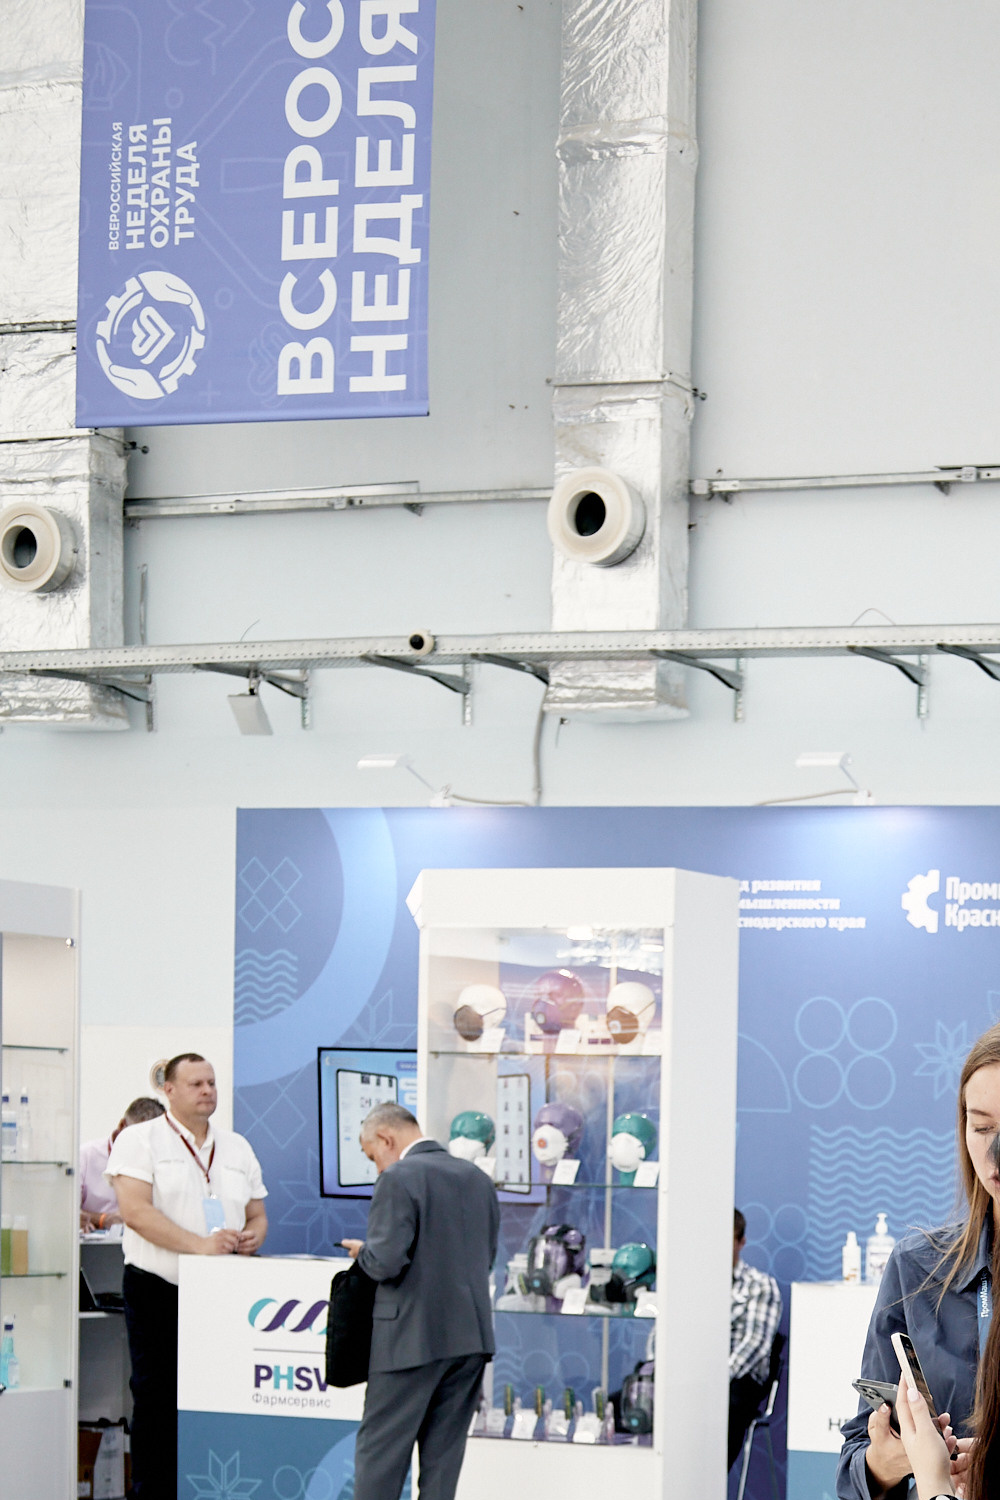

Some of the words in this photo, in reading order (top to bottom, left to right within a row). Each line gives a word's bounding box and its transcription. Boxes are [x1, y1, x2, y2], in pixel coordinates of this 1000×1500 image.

[108, 122, 123, 250] ВСЕРОССИЙСКАЯ
[126, 124, 149, 249] НЕДЕЛЯ
[150, 118, 172, 249] ОХРАНЫ
[174, 141, 200, 246] ТРУДА
[349, 0, 423, 393] НЕДЕЛЯ
[251, 1393, 331, 1409] Фармсервис
